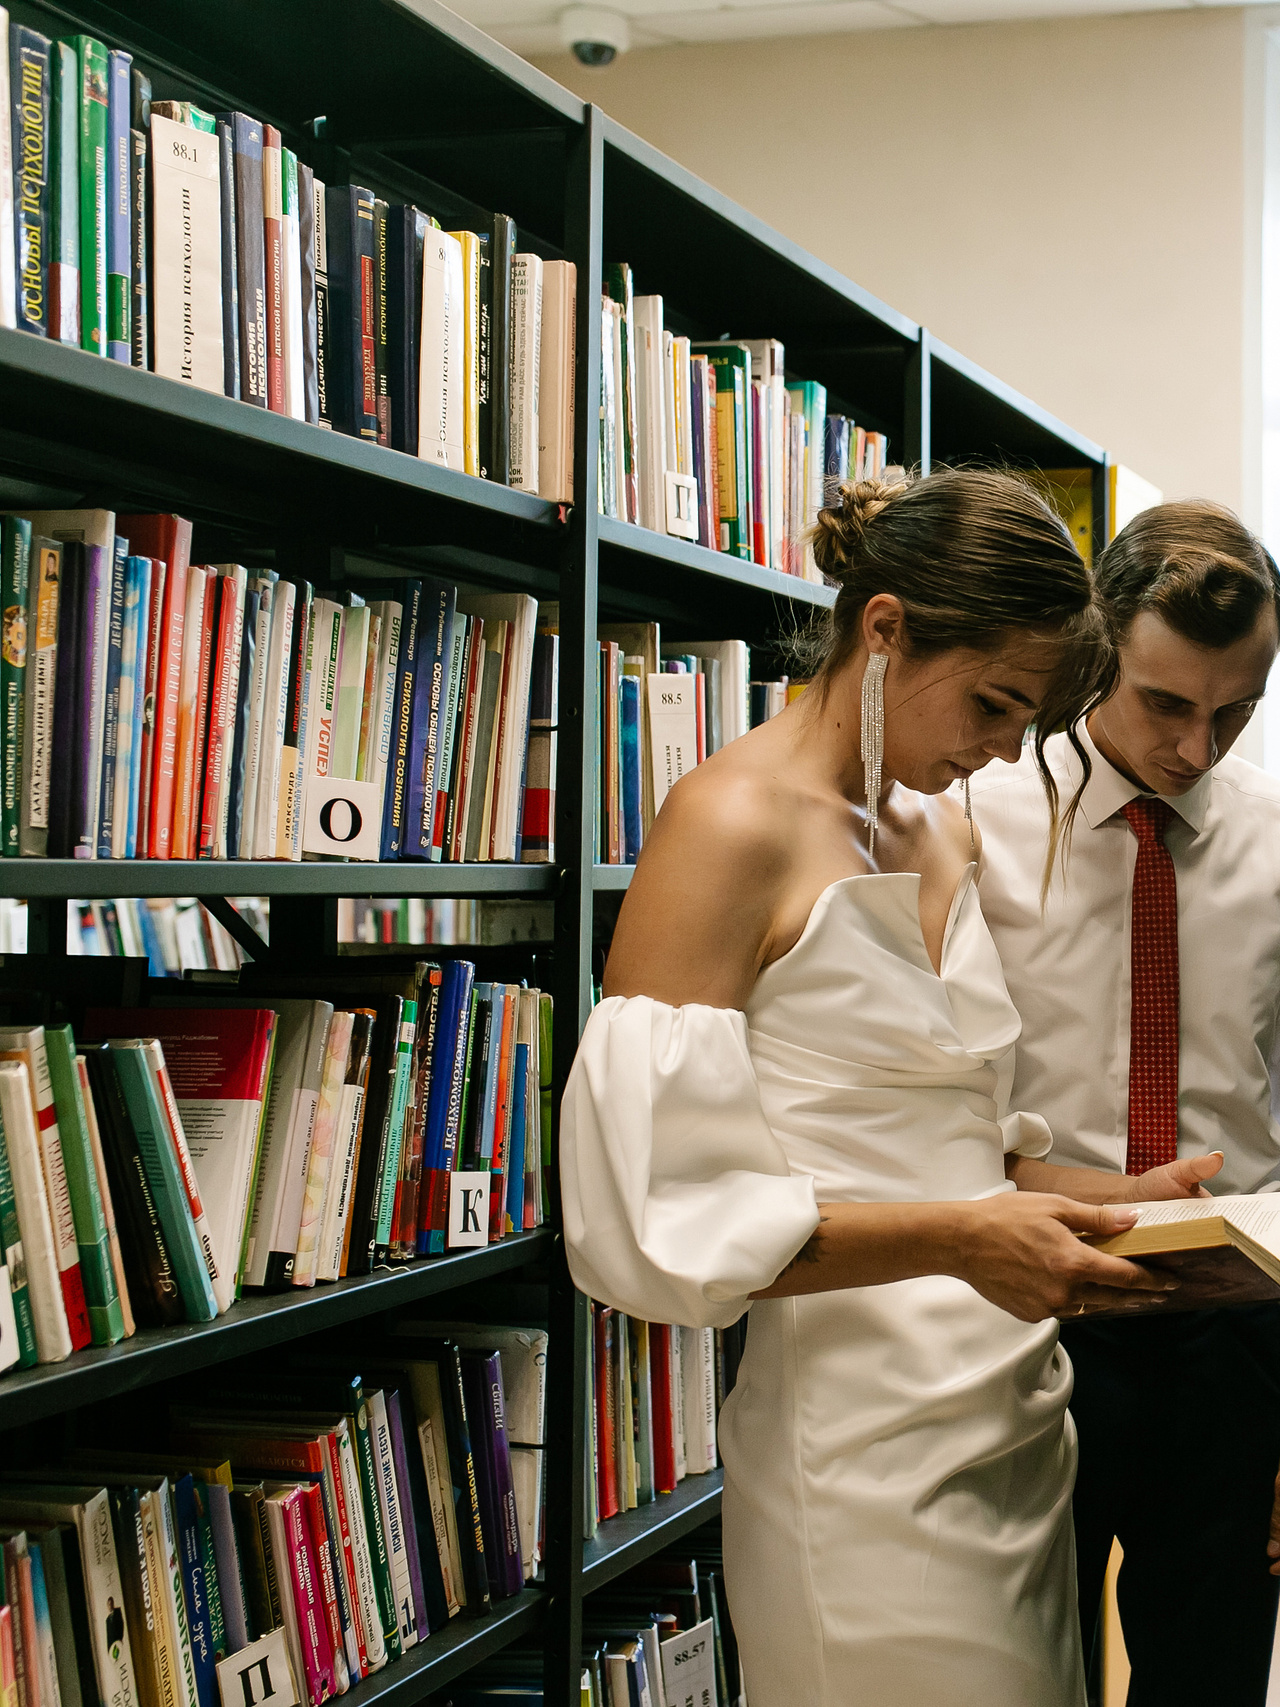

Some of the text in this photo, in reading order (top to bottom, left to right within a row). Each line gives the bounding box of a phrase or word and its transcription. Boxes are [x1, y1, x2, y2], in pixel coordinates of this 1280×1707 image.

[118, 136, 128, 216] ПСИХОЛОГИЯ
[173, 141, 199, 163] 88.1
[20, 59, 43, 323] ОСНОВЫ ПСИХОЛОГИИ
[180, 187, 195, 381] История психологии
[273, 239, 281, 309] ПСИХОЛОГИИ
[248, 322, 257, 395] ИСТОРИЯ
[256, 288, 266, 398] ПСИХОЛОГИИ
[274, 309, 282, 357] ДЕТСКОЙ
[316, 290, 327, 414] Болезнь культуры
[364, 349, 372, 401] ЗИГМУНД
[438, 388, 450, 442] Общая
[674, 484, 692, 521] П
[12, 533, 22, 594] АЛЕКСАНДР
[40, 599, 50, 639] ТАМАРА
[110, 548, 124, 648] ДЕЙЛ КАРНЕГИ
[408, 590, 420, 660] Антти Ревонсуо
[256, 620, 268, 704] ДЭВИД МАЙЕРС
[436, 611, 446, 656] Рубинштейн
[38, 657, 46, 686] ИМЯ
[164, 612, 184, 778] БЕЗУМНО ЗАНЯТ
[218, 648, 232, 728] ИСПОЛНЯЮЩИЙ
[276, 719, 284, 736] 12
[280, 658, 288, 714] недель
[284, 602, 295, 638] году
[292, 653, 303, 732] ПРОИСХОЖДЕНИЕ
[381, 616, 400, 754] ПРИВЫЧКА ГЕНИЯ
[661, 693, 682, 704] 88.5
[6, 682, 17, 809] ФЕНОМЕН ЗАВИСТИ
[34, 703, 44, 778] РОЖДЕНИЯ
[105, 694, 114, 757] ПРАВИЛА ЖИЗНИ
[251, 720, 260, 780] ИНТУИЦИЯ
[316, 718, 332, 777] УСПЕХ
[392, 672, 412, 828] ПСИХОЛОГИЯ СОЗНАНИЯ
[422, 662, 442, 830] ОСНОВЫ ОБЩЕЙ ПСИХОЛОГИИ
[33, 782, 42, 816] ДАТА
[102, 822, 112, 838] 21
[284, 771, 295, 839] александр
[320, 798, 362, 842] О
[317, 1046, 326, 1072] Джеймс
[420, 987, 440, 1138] ЭМОЦИИ И ЧУВСТВА
[444, 1009, 466, 1150] ПСИХОМОТОРНАЯ
[491, 1043, 499, 1116] ЛОГОПСИХОЛОГИЯ
[165, 1092, 187, 1156] РАВНОВЕСИИ
[306, 1126, 312, 1138] не
[309, 1100, 318, 1124] Дело
[352, 1092, 362, 1121] Теория
[301, 1150, 309, 1176] генах
[346, 1122, 356, 1158] речевой
[374, 1120, 390, 1218] Осторожно, нарцисс!
[182, 1170, 198, 1200] ЖИЗНЬ
[338, 1159, 351, 1218] деятельности
[458, 1188, 484, 1234] К
[132, 1156, 178, 1298] Никаких ограничений
[344, 1458, 360, 1546] ЭКСПЕРИМЕНТАЛЬНОЙ
[364, 1436, 386, 1564] ПСИХОФИЗИОЛОГИЯ
[377, 1424, 402, 1554] ПСИХОЛОГИЧЕСКИЕ ТЕСТЫ
[466, 1452, 484, 1553] ЧЕЛОВЕК И МИР
[294, 1500, 304, 1542] НАТАЛЬЯ
[508, 1490, 518, 1552] Календарь
[134, 1510, 154, 1630] ОТ СЛОВ К ДЕЛУ!
[152, 1566, 160, 1598] САМИМ
[204, 1559, 219, 1642] МУЖЧИНА
[296, 1550, 305, 1590] ЖЕЛАТЬ
[300, 1545, 314, 1604] РОЖДЕННАЯ
[322, 1572, 332, 1604] ЖЕНОЙ
[324, 1540, 336, 1600] РОЖДЕННАЯ
[361, 1582, 366, 1592] ПО
[173, 1570, 189, 1648] ОПЫТ
[191, 1566, 207, 1662] Сила духа
[212, 1585, 224, 1637] ТВОЕЙ
[364, 1596, 374, 1642] ПРАКТИКУМ
[237, 1654, 276, 1707] П
[674, 1640, 706, 1666] 88.57
